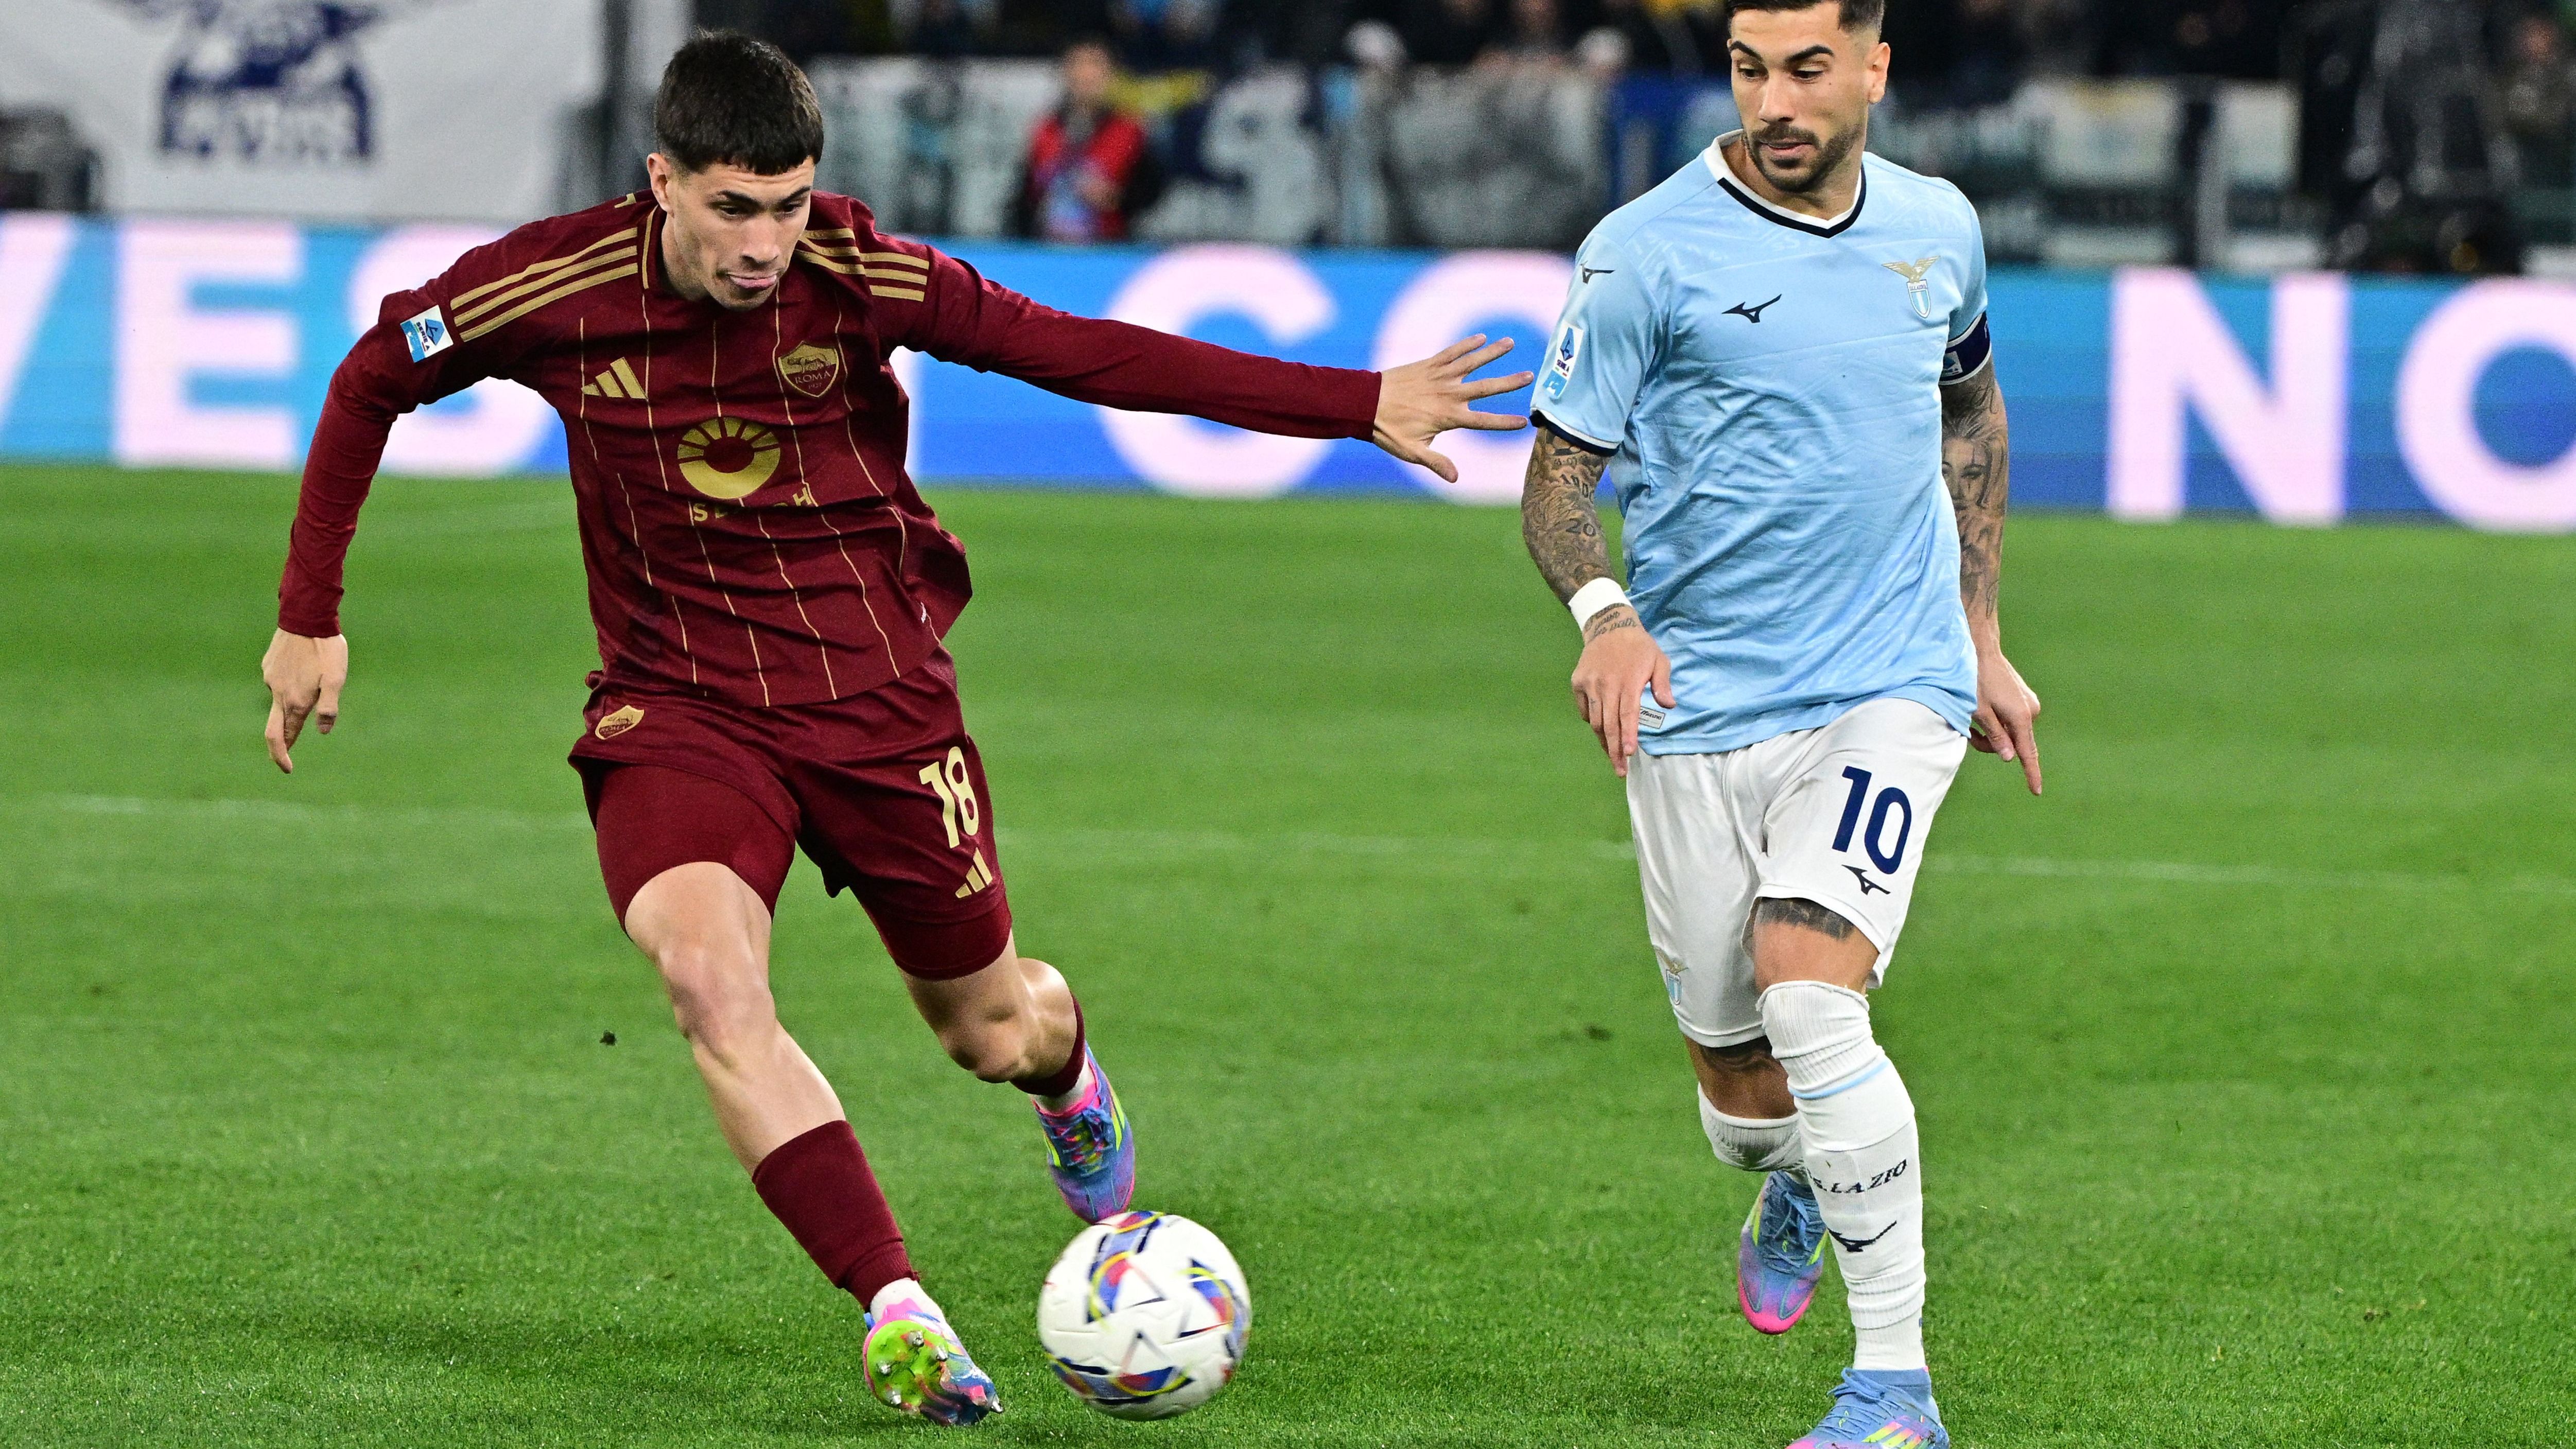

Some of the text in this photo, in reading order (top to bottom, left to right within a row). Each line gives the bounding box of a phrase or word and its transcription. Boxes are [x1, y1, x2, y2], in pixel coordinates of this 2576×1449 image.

[795, 370, 831, 384] ROMA
[2105, 265, 2576, 535] NO
[919, 746, 979, 849] 18
[1832, 765, 1912, 875] 10
